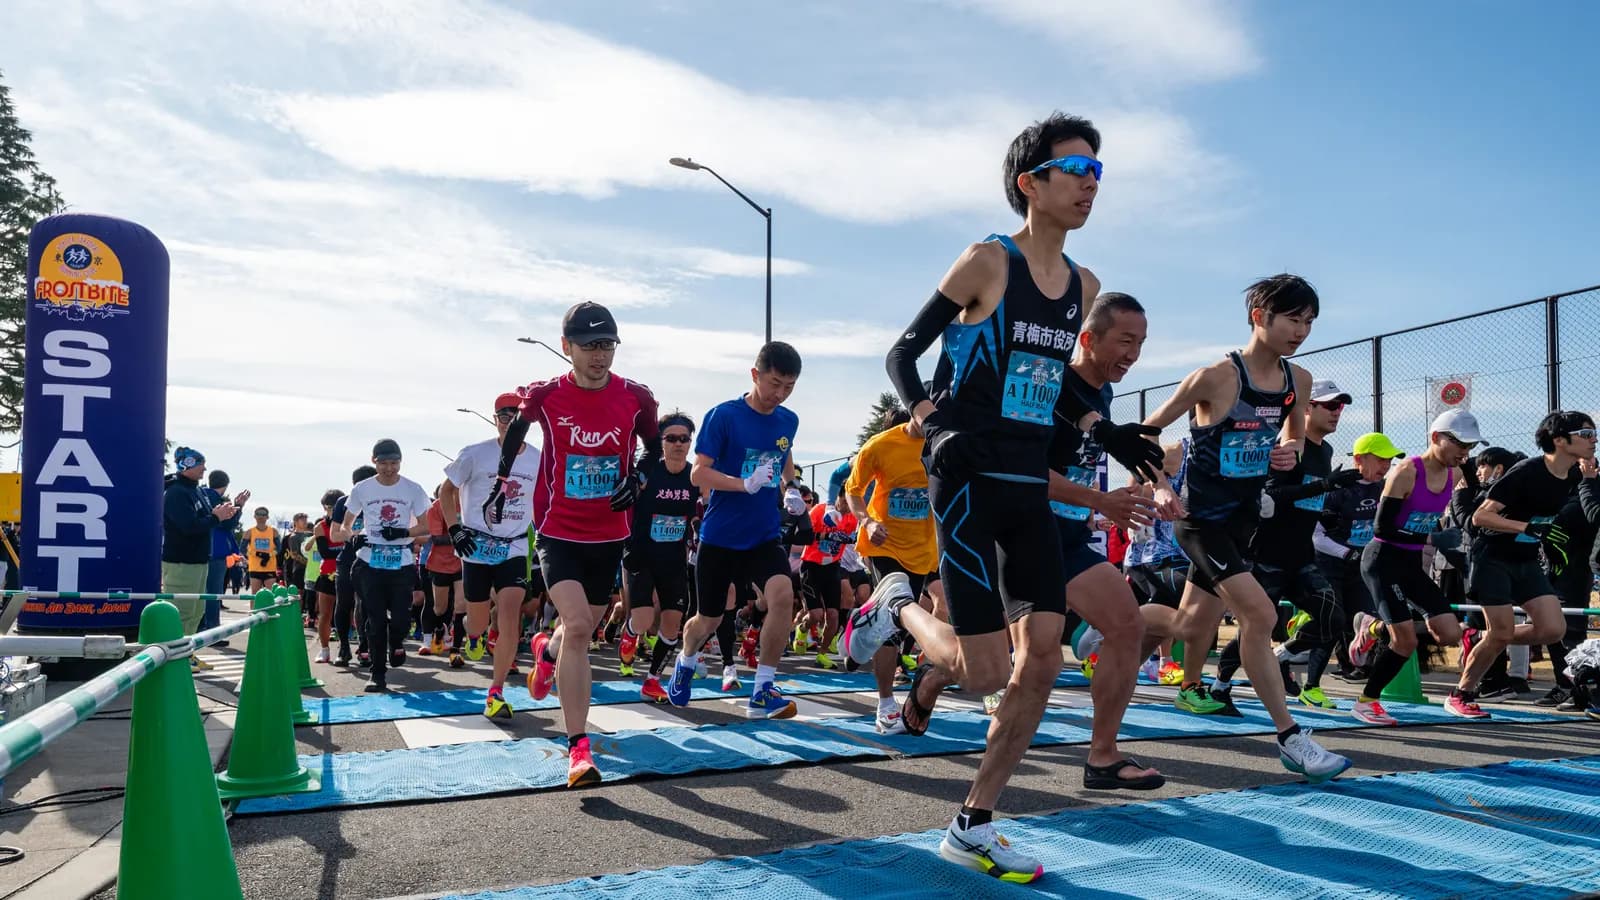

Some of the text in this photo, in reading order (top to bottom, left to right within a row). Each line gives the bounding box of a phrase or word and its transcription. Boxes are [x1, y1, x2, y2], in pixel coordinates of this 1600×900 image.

[36, 280, 129, 305] FROSTBITE
[1012, 321, 1076, 351] 青梅市役所
[1007, 383, 1016, 398] A
[36, 329, 114, 592] START
[1223, 453, 1230, 463] A
[568, 471, 617, 486] A 11004
